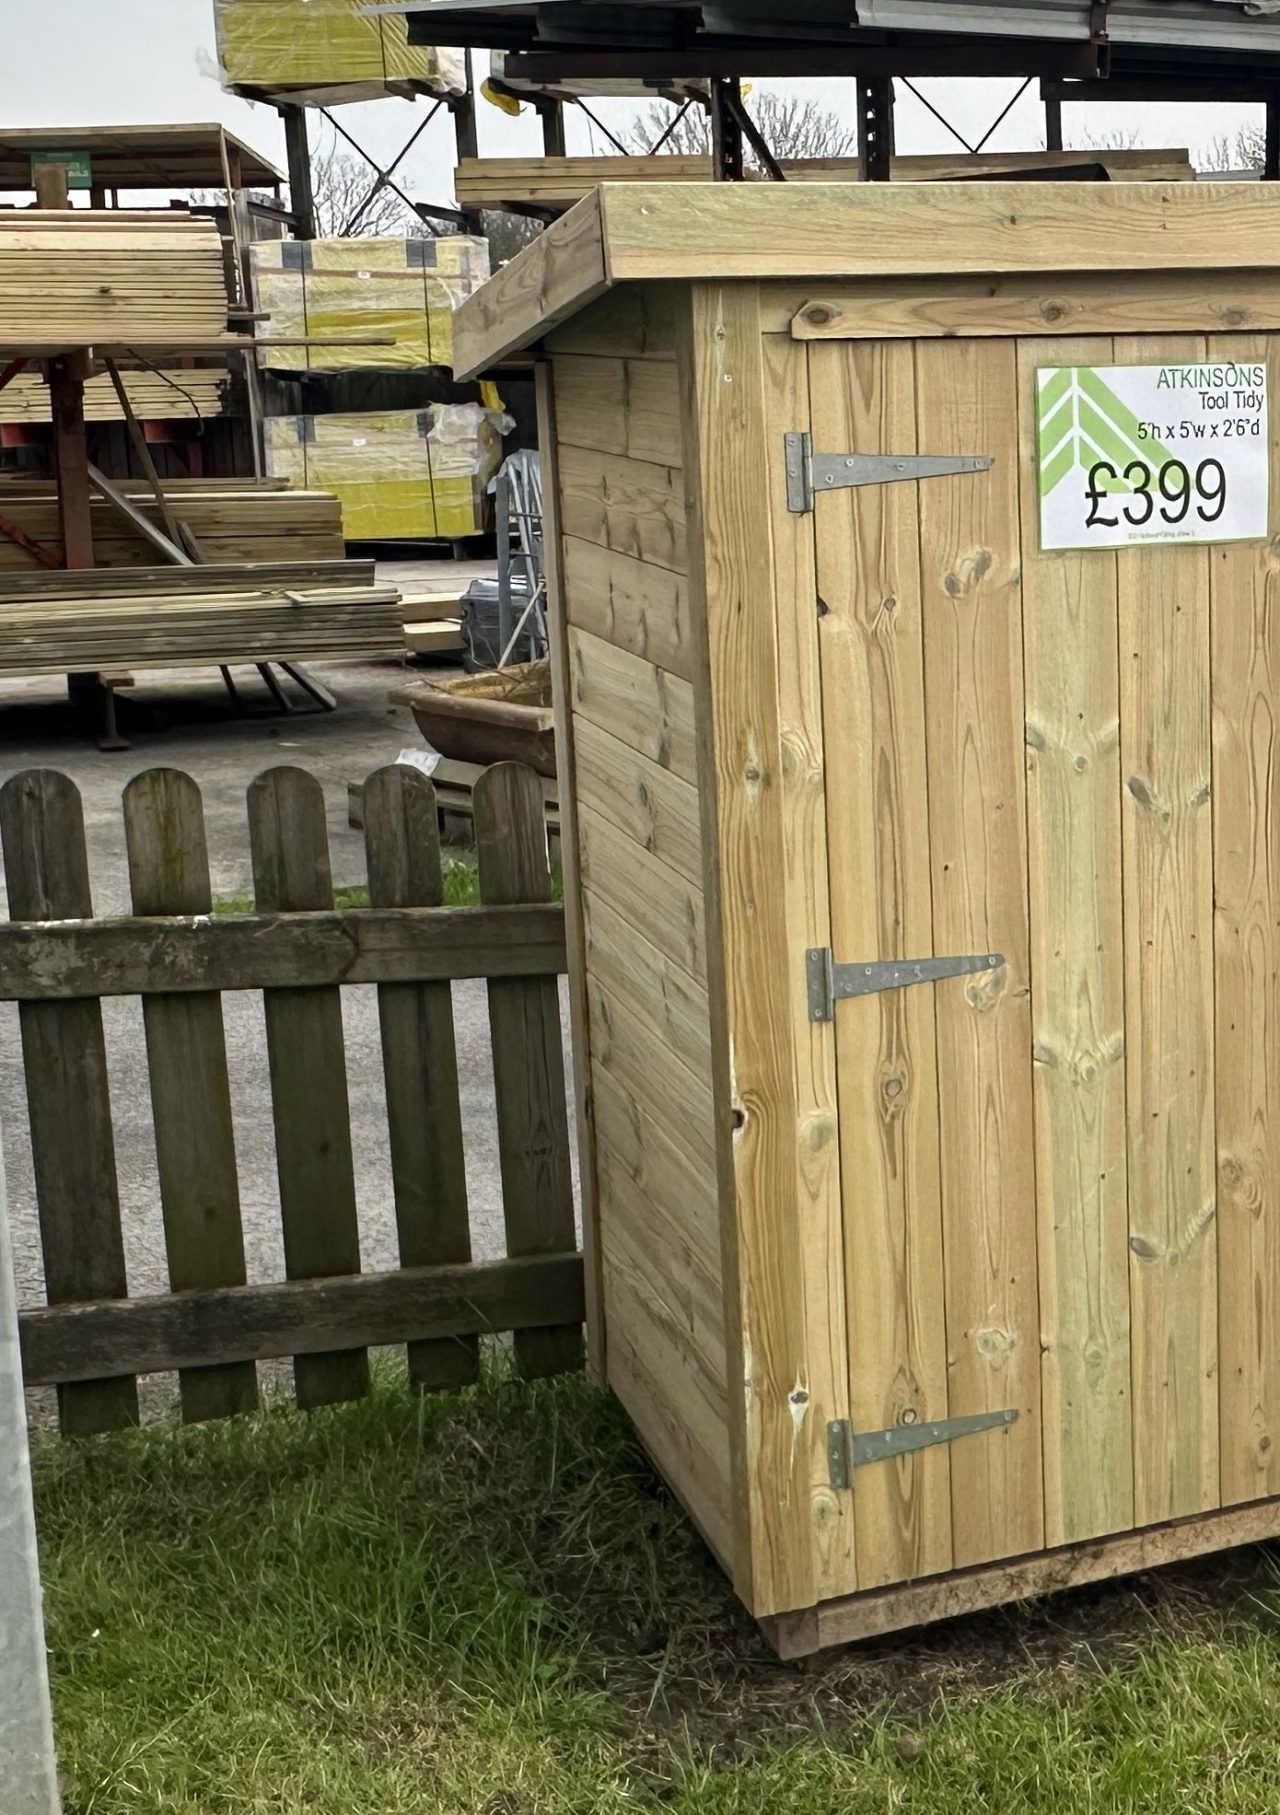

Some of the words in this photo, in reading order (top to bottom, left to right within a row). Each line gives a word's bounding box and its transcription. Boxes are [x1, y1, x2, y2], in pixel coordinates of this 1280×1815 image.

[1156, 366, 1264, 389] ATKINSONS
[1198, 391, 1228, 410] Tool
[1232, 390, 1264, 412] Tidy
[1165, 425, 1176, 439] x
[1210, 424, 1219, 438] x
[1085, 458, 1226, 529] £399
